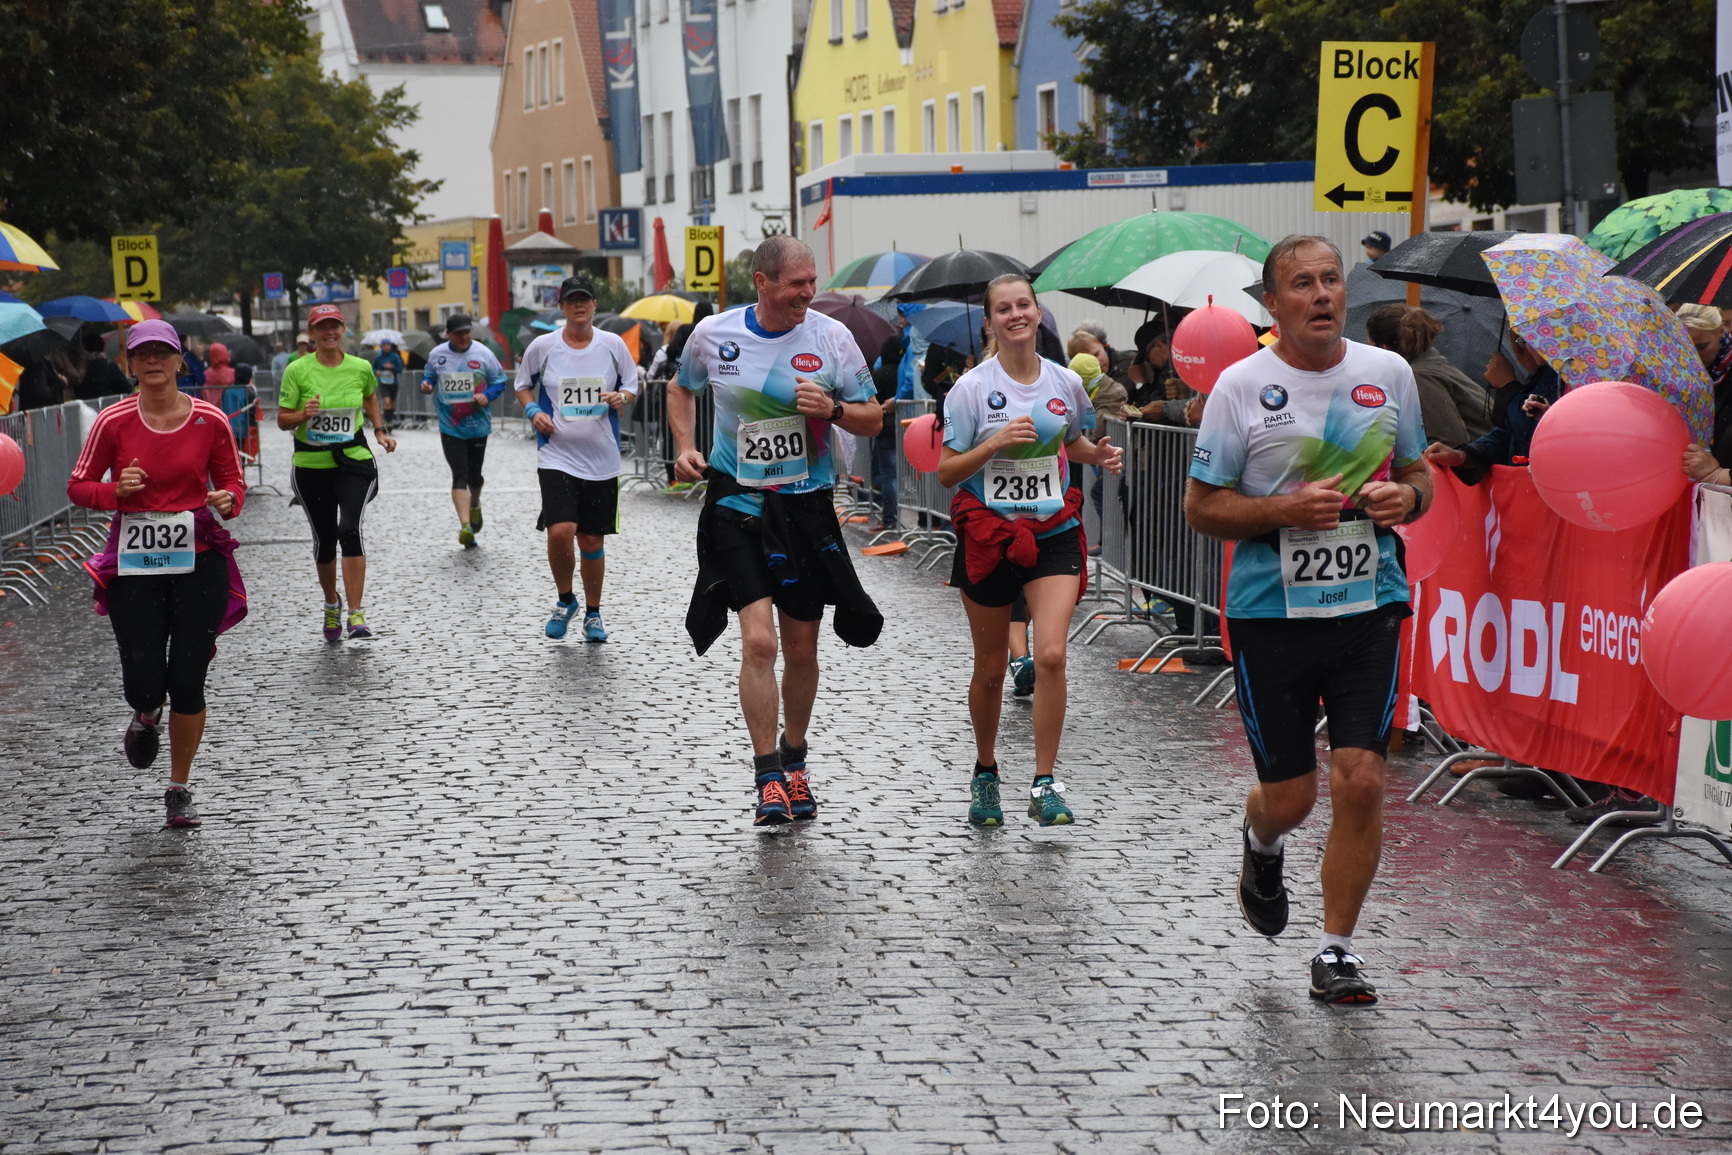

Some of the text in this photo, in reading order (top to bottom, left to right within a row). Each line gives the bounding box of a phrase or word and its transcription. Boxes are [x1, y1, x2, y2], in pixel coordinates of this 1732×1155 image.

[1334, 49, 1420, 79] Block
[844, 73, 871, 103] HOTEL
[1344, 93, 1402, 176] C
[689, 228, 720, 240] Block
[117, 238, 152, 251] Block
[695, 246, 714, 277] D
[125, 255, 148, 288] D
[718, 364, 740, 372] PARTL
[444, 380, 471, 391] 2225
[563, 386, 602, 404] 2111
[575, 407, 592, 416] Tanja
[1263, 412, 1295, 424] PARTL
[312, 415, 351, 432] 2350
[763, 418, 801, 431] BOCK
[1265, 420, 1296, 429] Neumarkt
[745, 432, 803, 461] 2380
[764, 465, 784, 476] Karl
[1020, 459, 1053, 471] BOCK
[993, 473, 1052, 501] 2381
[1014, 504, 1038, 512] Lena
[126, 524, 188, 550] 2032
[143, 555, 171, 567] Birgit
[1292, 543, 1371, 582] 2292
[1318, 588, 1348, 604] Josef
